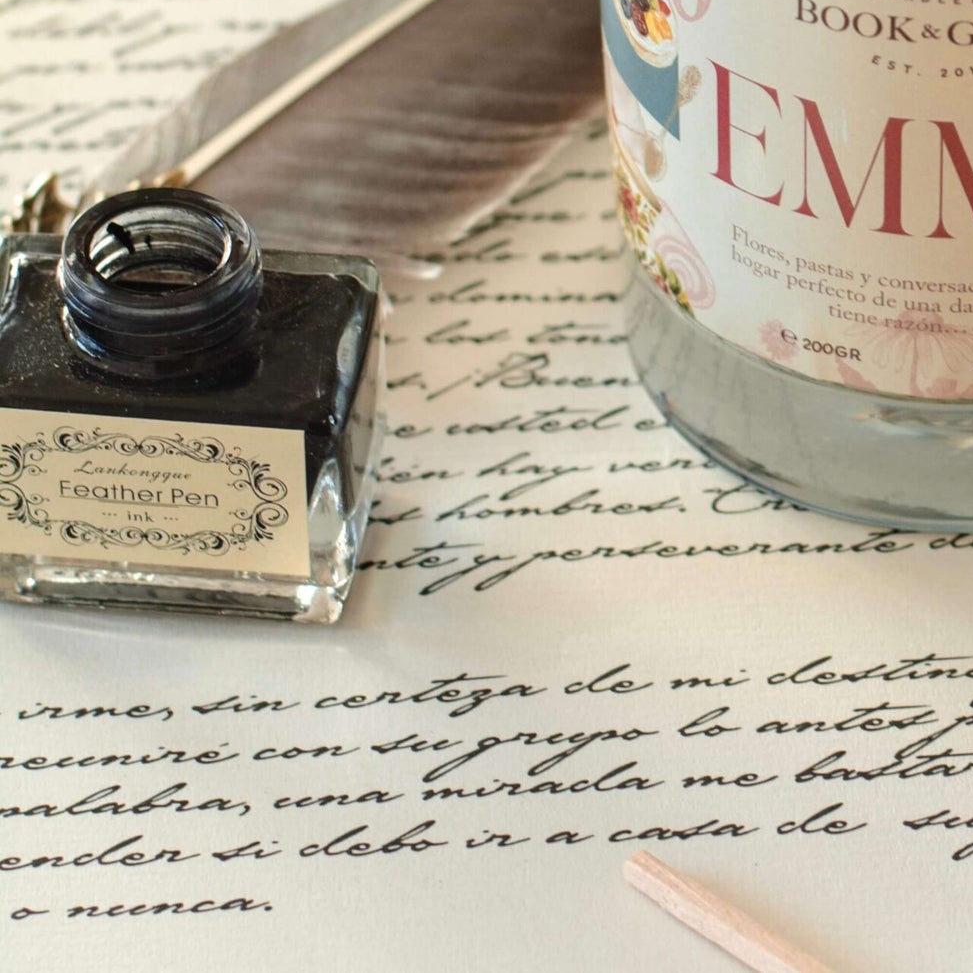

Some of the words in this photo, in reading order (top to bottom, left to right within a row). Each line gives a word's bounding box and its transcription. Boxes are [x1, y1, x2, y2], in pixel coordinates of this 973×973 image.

[871, 54, 921, 77] EST.
[731, 224, 791, 267] Flores,
[795, 256, 855, 282] pastas
[859, 273, 873, 289] y
[731, 244, 780, 280] hogar
[786, 272, 867, 304] perfecto
[871, 289, 898, 309] de
[903, 298, 942, 314] una
[828, 301, 879, 327] tiene
[802, 336, 863, 363] 200GR
[58, 479, 164, 504] Feather
[171, 487, 220, 508] Pen
[435, 488, 687, 523] hombres.
[127, 510, 155, 524] ink
[357, 541, 485, 572] nte
[18, 702, 174, 722] irme,
[192, 694, 300, 715] sin
[313, 672, 549, 719] certeza
[563, 663, 653, 695] de
[670, 667, 750, 691] mi
[252, 742, 361, 762] con
[369, 732, 465, 753] su
[422, 725, 658, 778] grupo
[677, 707, 744, 738] lo
[755, 701, 941, 736] antes
[272, 788, 406, 811] una
[421, 761, 665, 800] mirada
[681, 765, 779, 790] me
[0, 834, 203, 872] ender
[211, 839, 283, 863] si
[299, 819, 450, 859] debo
[465, 828, 531, 851] ir
[545, 828, 595, 847] a
[607, 819, 762, 845] casa
[775, 802, 870, 836] de
[10, 904, 50, 922] o
[66, 894, 276, 920] nunca.
